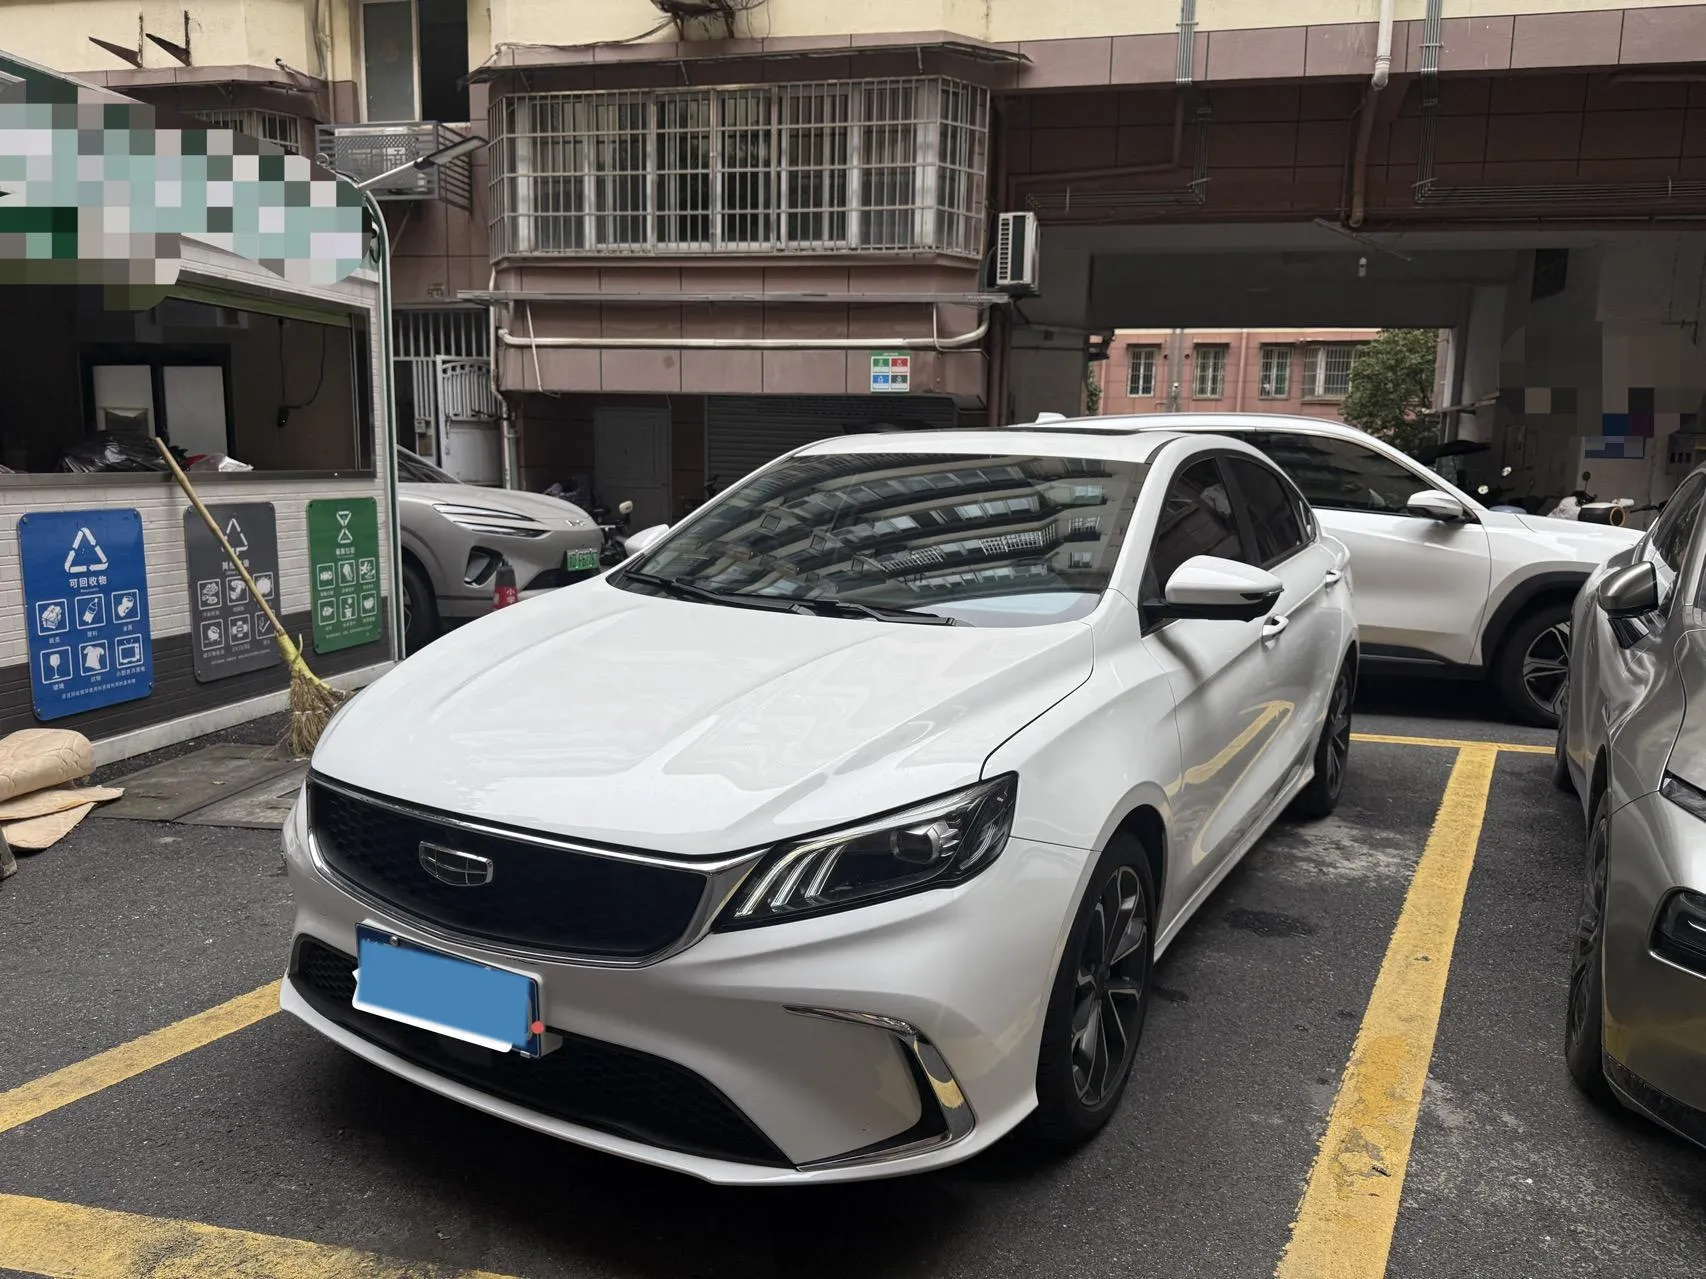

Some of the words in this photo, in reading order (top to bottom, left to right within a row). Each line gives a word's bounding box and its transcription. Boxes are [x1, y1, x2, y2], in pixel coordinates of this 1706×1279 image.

[222, 559, 249, 570] 其他圾
[69, 576, 107, 588] 可回收物
